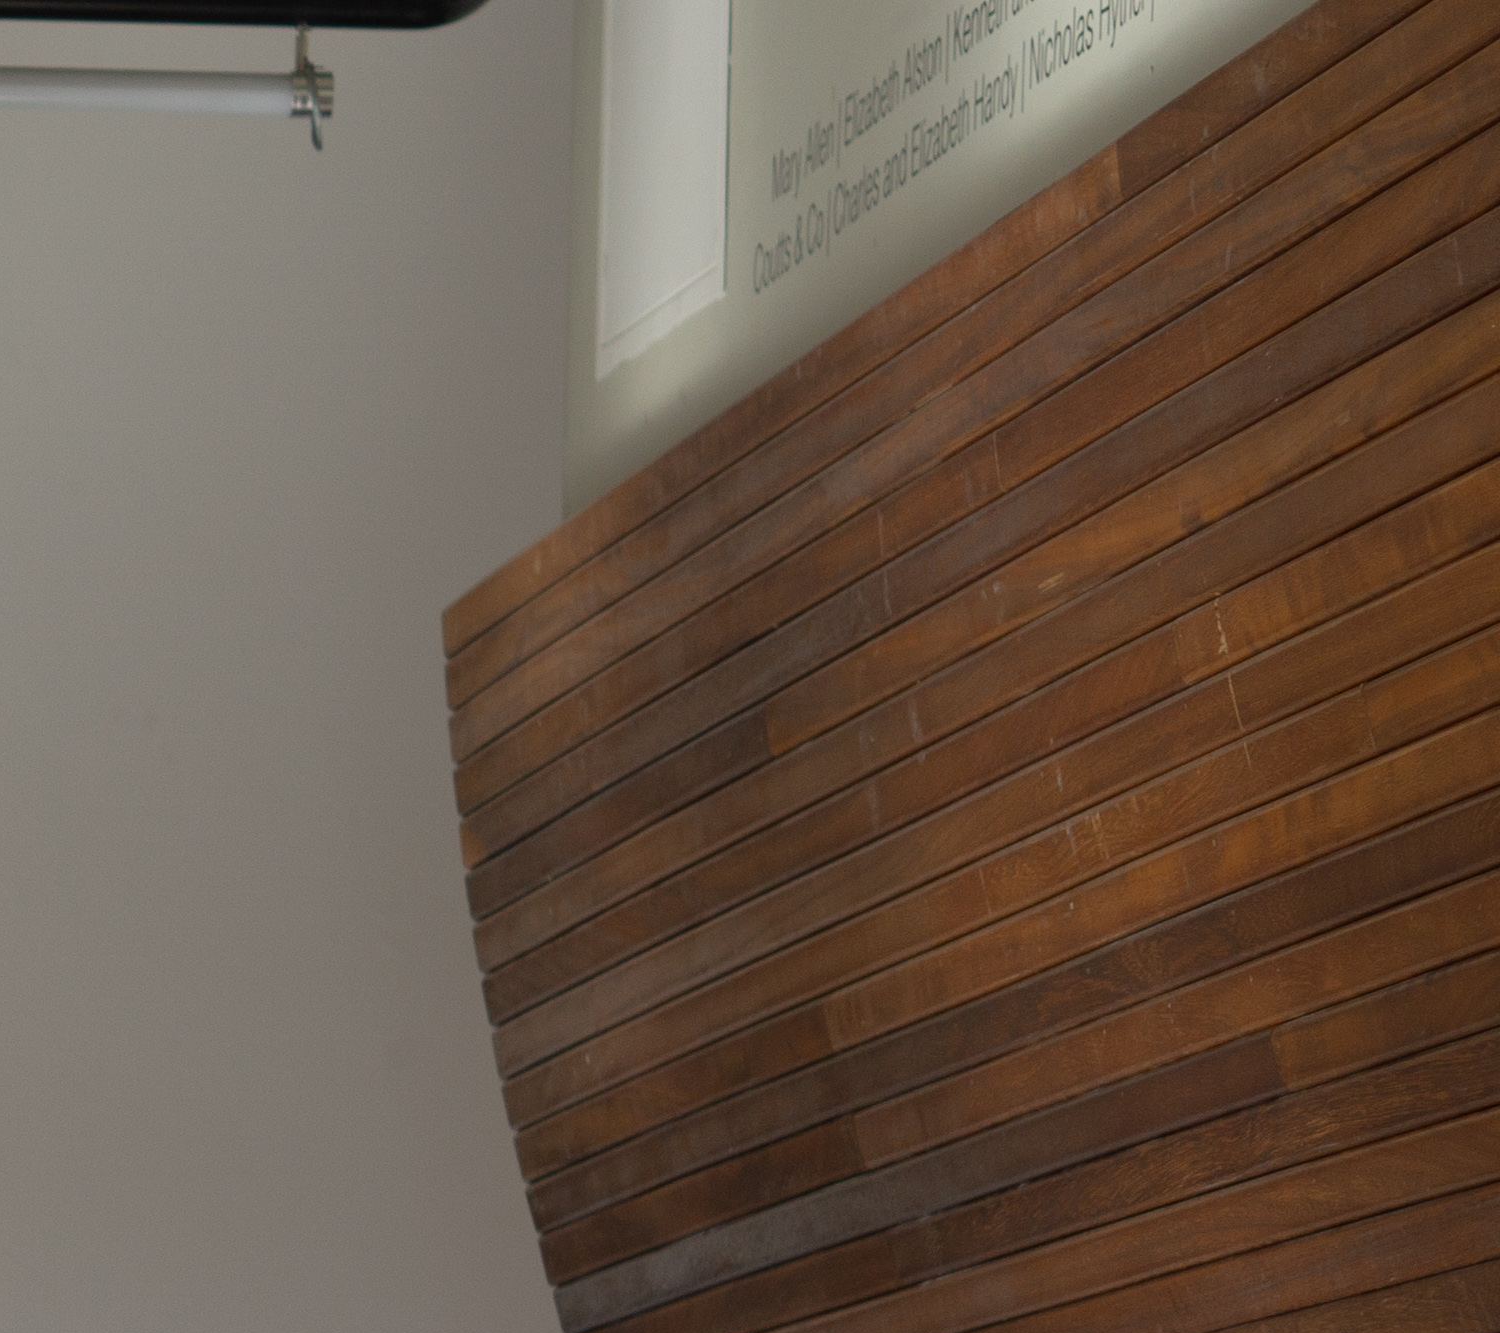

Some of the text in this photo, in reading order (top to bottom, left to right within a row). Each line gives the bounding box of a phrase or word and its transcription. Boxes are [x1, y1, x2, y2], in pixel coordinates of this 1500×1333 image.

[753, 230, 791, 294] Coutts
[806, 202, 824, 255] Co
[833, 164, 880, 235] Charles
[883, 133, 908, 198] and
[910, 88, 970, 178] Elizabeth
[973, 54, 1019, 131] Handy
[1029, 6, 1095, 89] Nicholas
[772, 148, 802, 201] Mary
[804, 119, 834, 178] Allen
[844, 60, 900, 146] Elizabeth
[902, 33, 943, 97] Alston
